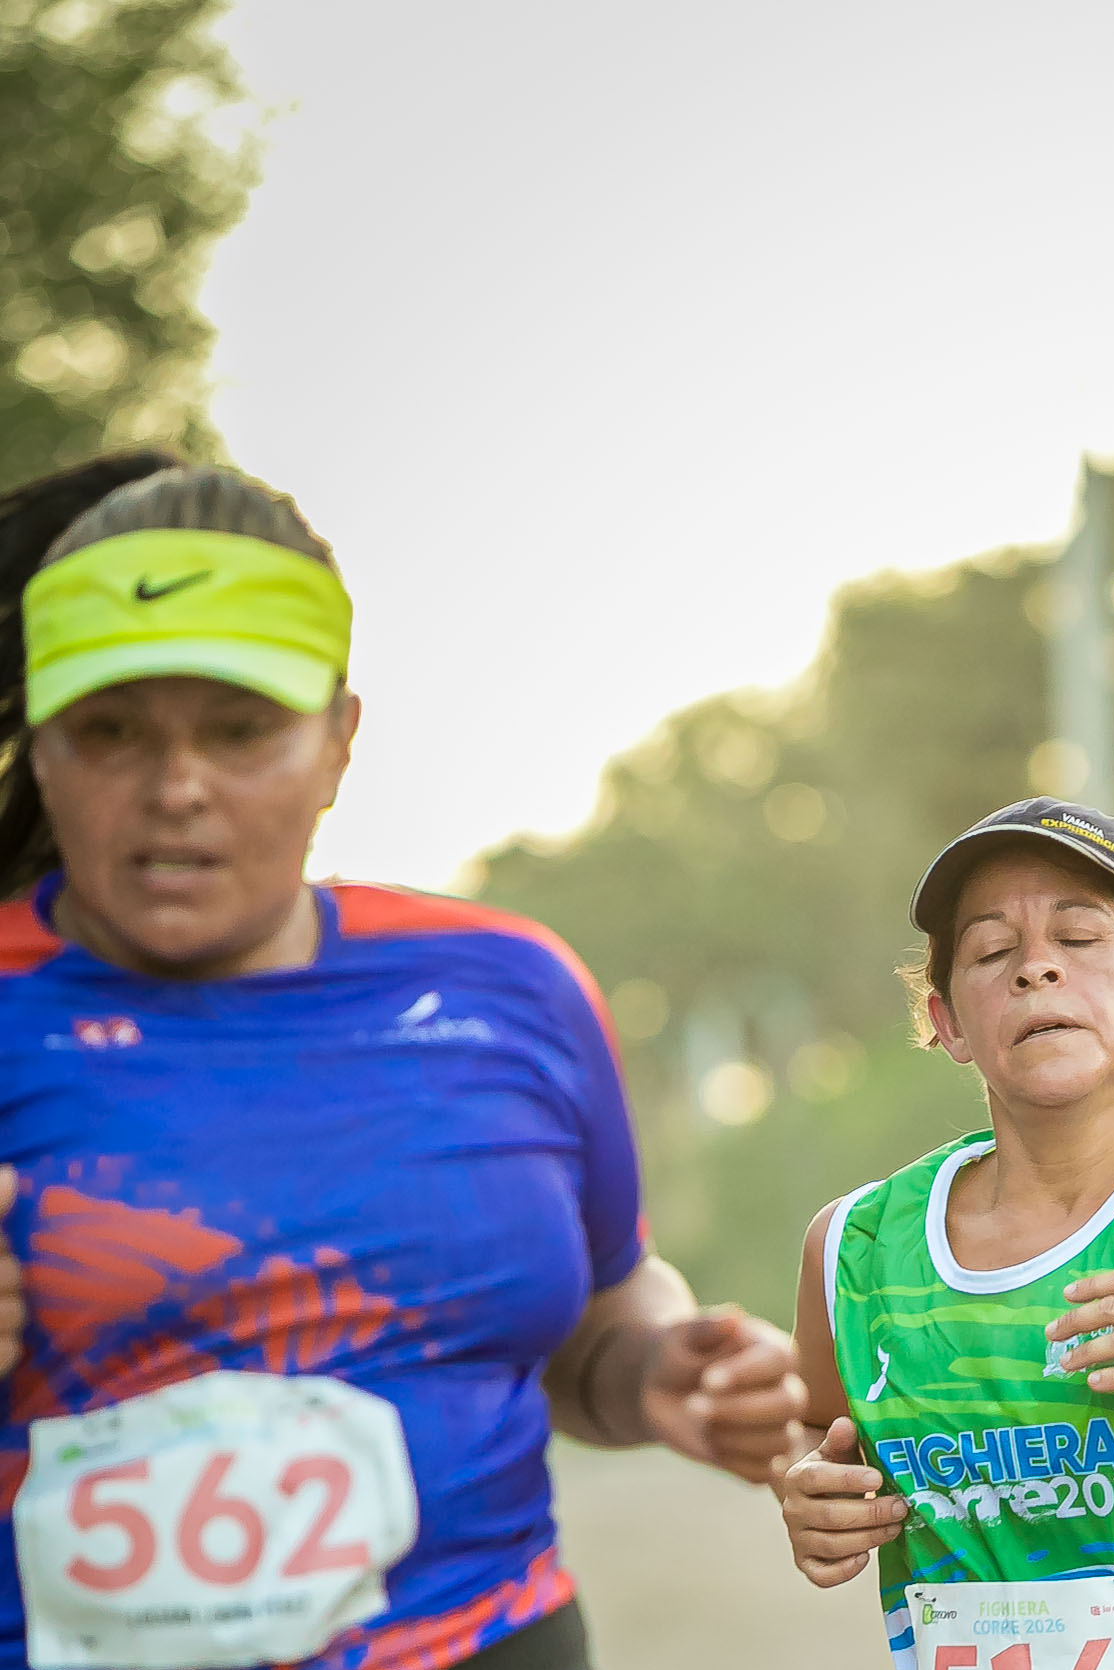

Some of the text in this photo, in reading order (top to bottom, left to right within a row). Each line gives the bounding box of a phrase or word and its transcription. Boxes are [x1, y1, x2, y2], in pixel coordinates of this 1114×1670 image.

[1062, 812, 1105, 840] YAMAHA
[65, 1452, 371, 1595] 562
[978, 1600, 1050, 1617] FIGHIERA
[973, 1617, 1066, 1636] CORRE 2026
